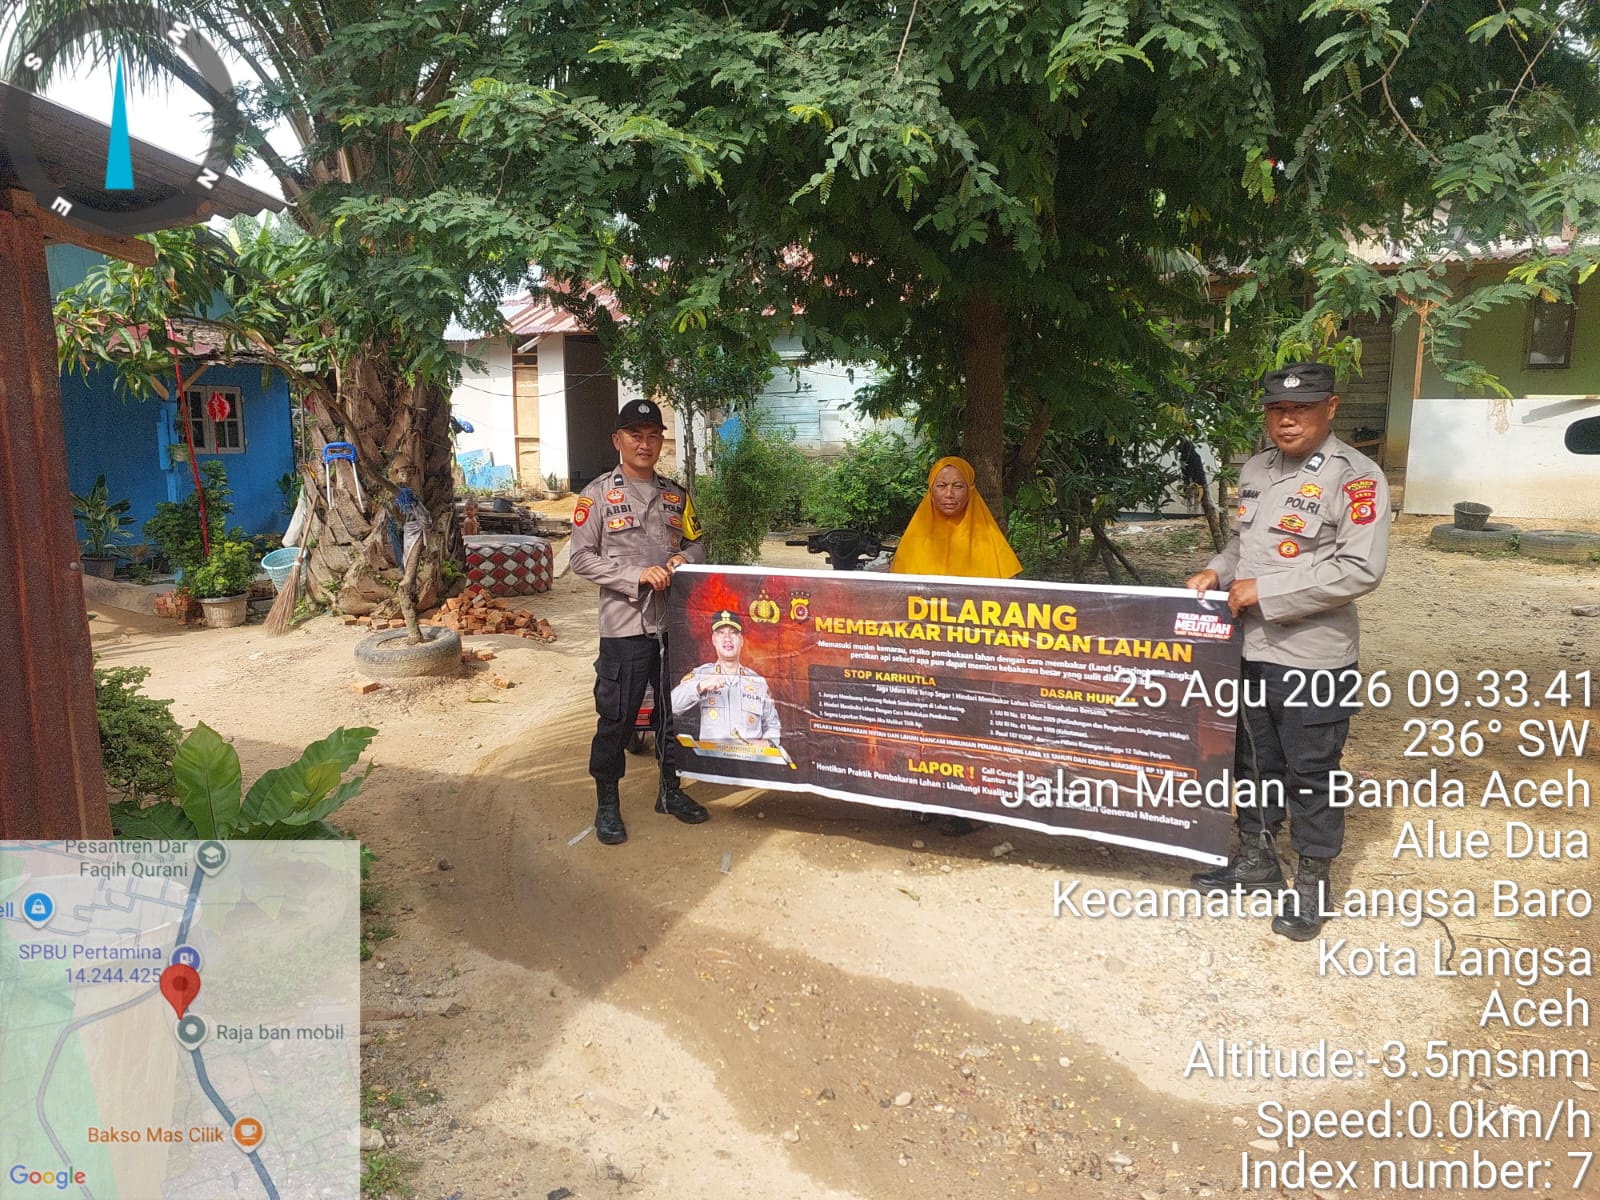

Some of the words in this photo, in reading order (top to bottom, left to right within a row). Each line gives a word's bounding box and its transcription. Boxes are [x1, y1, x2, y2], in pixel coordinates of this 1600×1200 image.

[605, 504, 632, 517] ARBI
[1284, 497, 1320, 514] POLRI
[907, 596, 1078, 631] DILARANG
[1174, 619, 1232, 635] MEUTUAH
[815, 617, 941, 641] MEMBAKAR
[947, 625, 1030, 649] HUTAN
[1036, 632, 1091, 653] DAN
[1098, 637, 1192, 663] LAHAN
[818, 640, 851, 649] Memasuki
[853, 643, 875, 651] musim
[909, 648, 930, 656] resiko
[932, 650, 973, 659] pembukaan
[975, 653, 995, 662] lahan
[997, 655, 1025, 665] dengan
[1027, 658, 1043, 666] cara
[1045, 660, 1087, 669] membakar
[1088, 662, 1111, 673] (Land
[850, 652, 879, 661] percikan
[880, 654, 890, 662] api
[892, 655, 915, 664] sekecil
[917, 657, 929, 666] apa
[931, 659, 944, 667] pun
[946, 659, 967, 669] dapat
[968, 662, 997, 671] memicu
[999, 664, 1038, 674] kebakaran
[1040, 667, 1062, 677] besar
[1063, 671, 1082, 680] yang
[1084, 671, 1101, 681] sulit
[844, 668, 872, 679] STOP
[875, 671, 936, 686] KARHUTLA
[935, 690, 951, 700] Segar
[1040, 688, 1082, 701] DASAR
[1086, 692, 1136, 705] HUK
[908, 759, 965, 778] LAPOR
[969, 766, 975, 779] !
[981, 766, 995, 775] Call
[982, 775, 1005, 785] Kantor
[816, 763, 846, 775] Hentikan
[848, 767, 872, 778] Praktik
[874, 771, 918, 785] Pembakaran
[919, 778, 941, 788] Lahan
[946, 781, 980, 795] Lindungi
[982, 787, 1013, 799] Kualitas
[1101, 806, 1137, 818] Generasi
[1139, 811, 1190, 830] Mendatang
